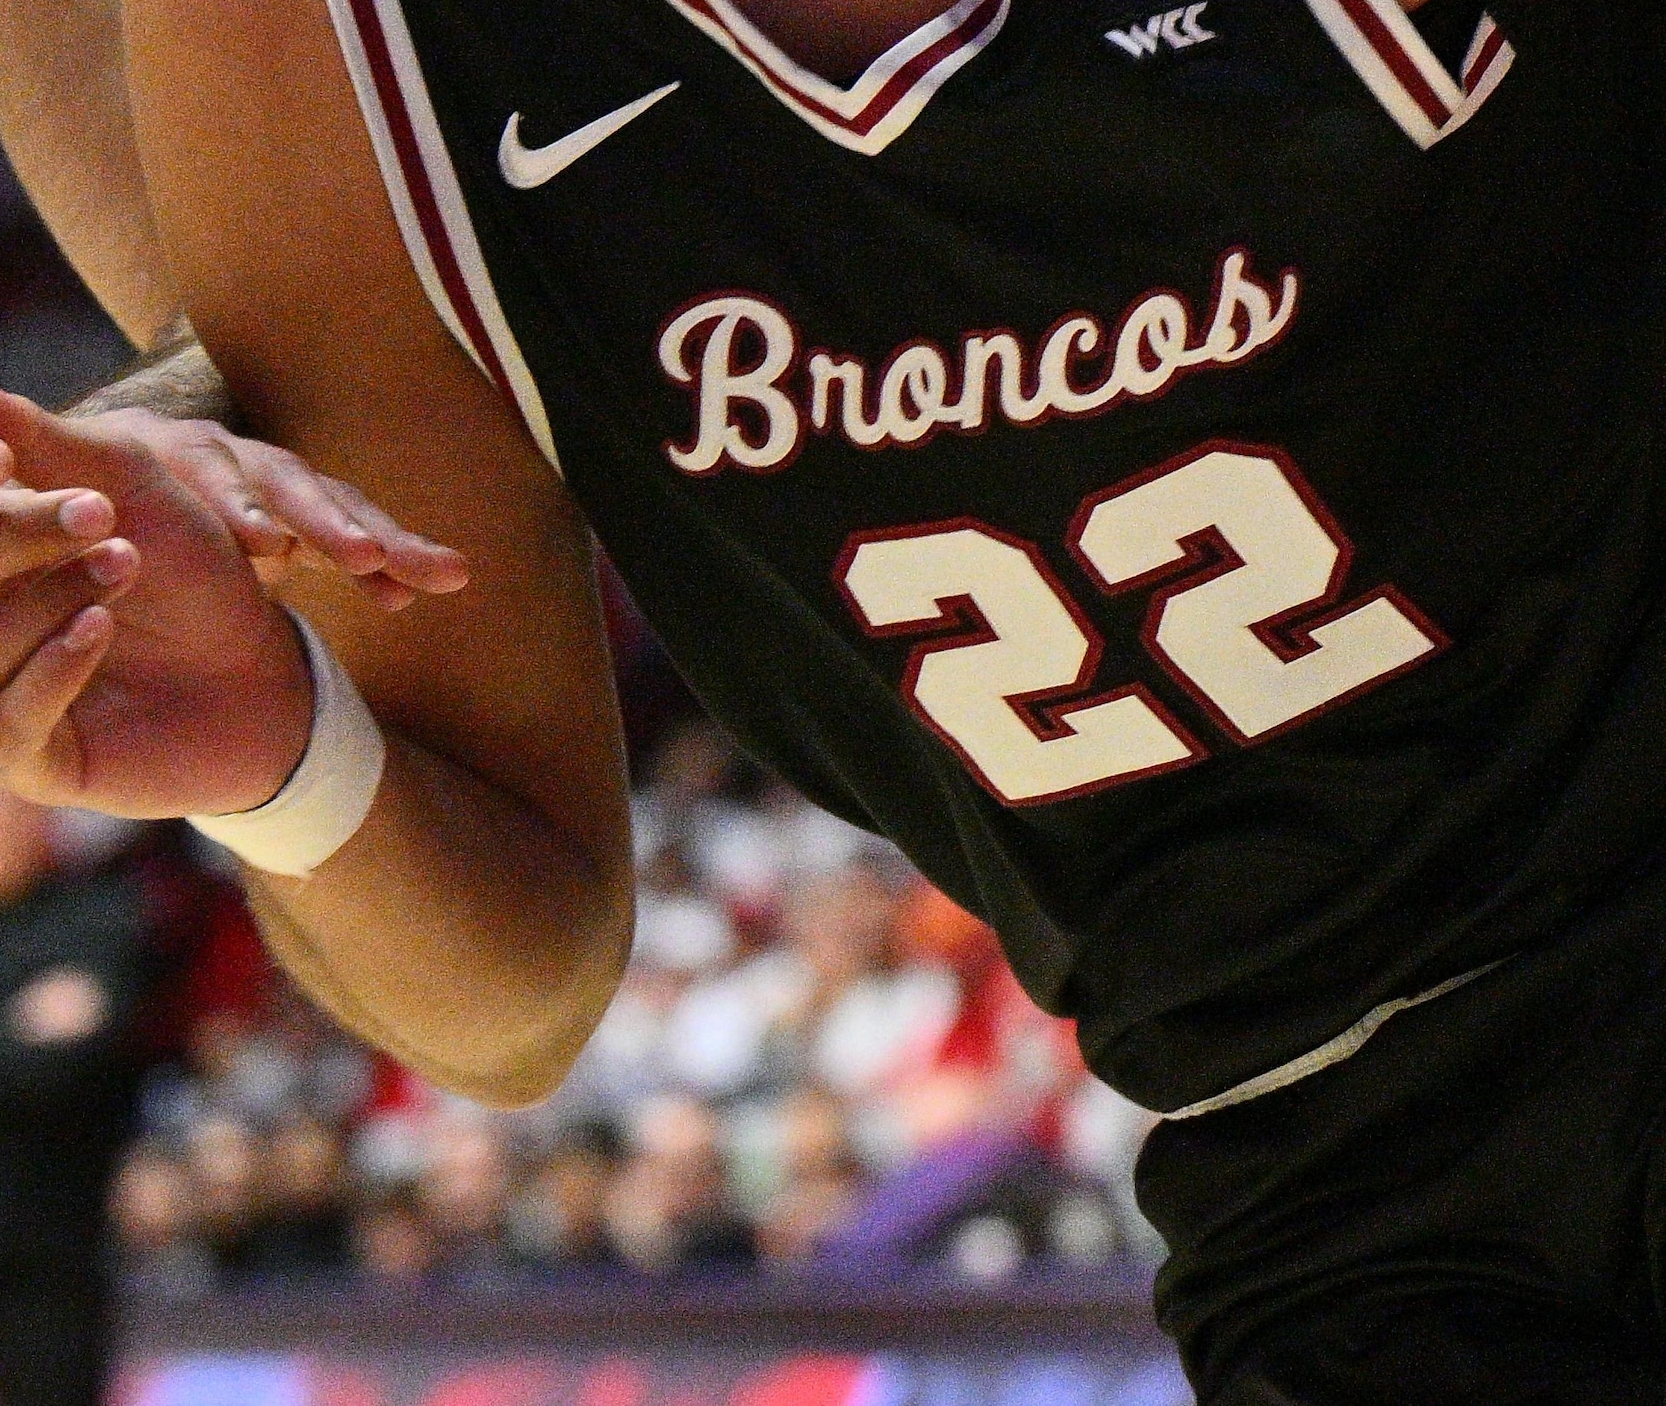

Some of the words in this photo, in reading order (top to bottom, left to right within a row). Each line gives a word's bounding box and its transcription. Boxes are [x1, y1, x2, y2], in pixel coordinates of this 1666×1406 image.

[1104, 1, 1216, 59] WCC
[653, 246, 1300, 476] Broncos
[834, 439, 1452, 806] 22
